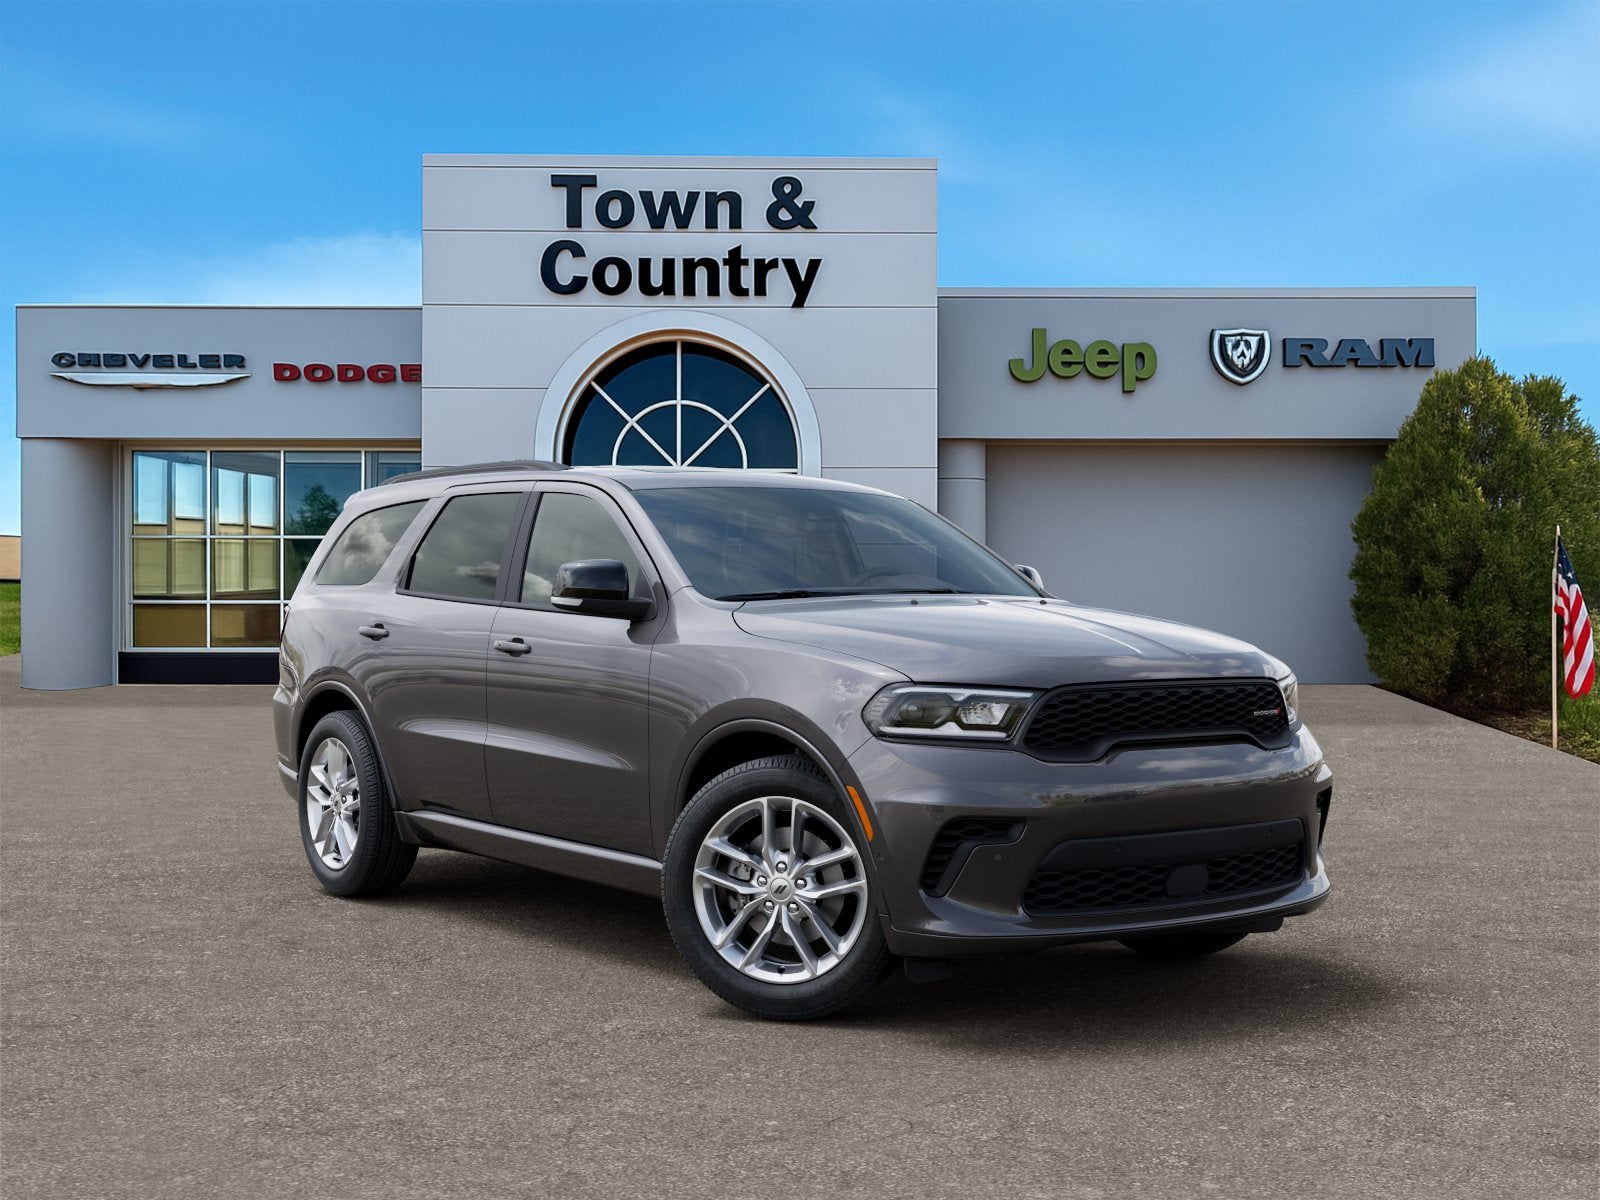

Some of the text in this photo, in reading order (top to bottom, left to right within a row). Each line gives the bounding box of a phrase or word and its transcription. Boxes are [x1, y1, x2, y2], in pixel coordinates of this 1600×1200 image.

[550, 174, 818, 230] Town &
[540, 239, 822, 308] Country
[273, 363, 422, 383] DODGE
[1009, 328, 1158, 392] Jeep
[1282, 338, 1436, 367] RAM
